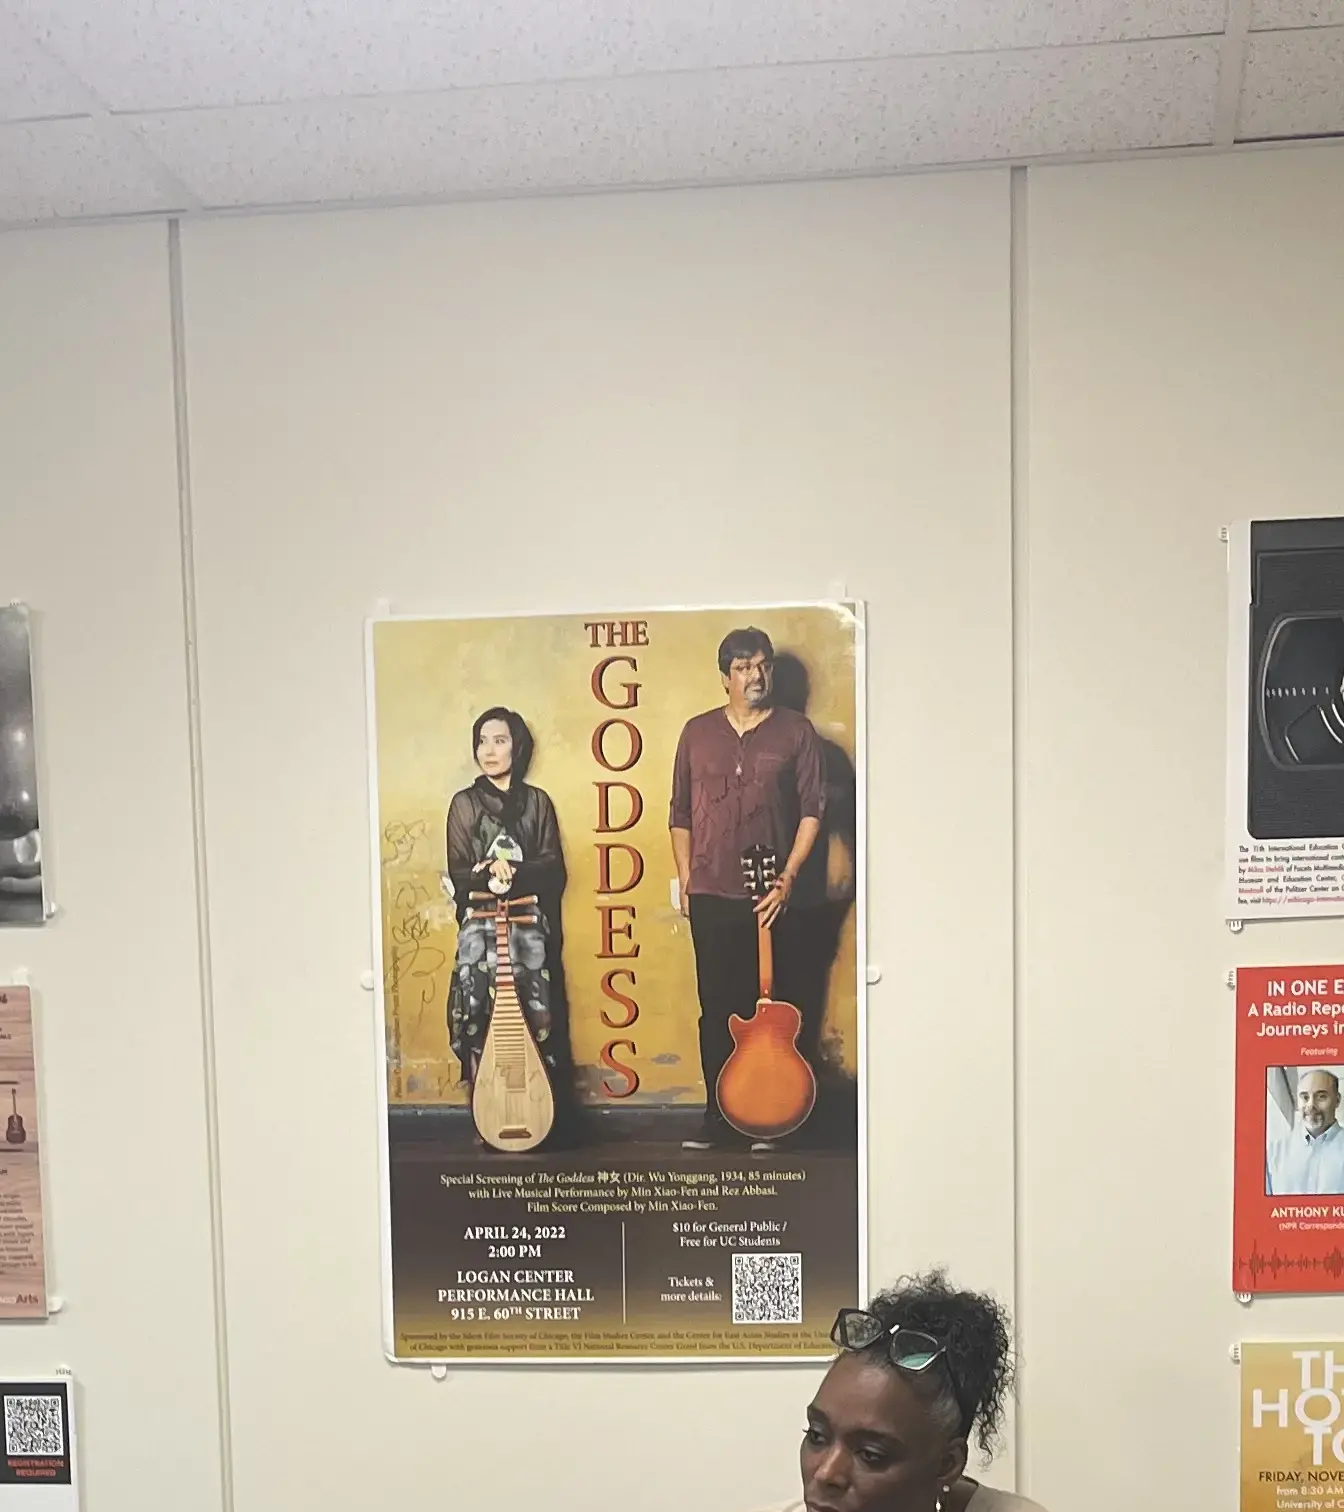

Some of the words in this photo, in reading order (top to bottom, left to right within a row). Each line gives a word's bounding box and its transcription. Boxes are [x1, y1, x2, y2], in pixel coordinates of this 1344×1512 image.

[585, 621, 649, 648] THE
[591, 656, 645, 1099] GODDESS
[1268, 980, 1285, 996] IN
[1291, 979, 1328, 996] ONE
[1248, 1003, 1259, 1017] A
[1263, 1001, 1306, 1017] Radio
[1256, 1022, 1328, 1039] Journeys
[440, 1174, 474, 1187] Special
[475, 1173, 523, 1187] Screening
[524, 1173, 535, 1184] of
[537, 1172, 554, 1184] The
[556, 1172, 595, 1185] Goddess
[648, 1170, 665, 1183] Wu
[667, 1170, 718, 1187] Yonggang,
[719, 1170, 745, 1184] 1934,
[748, 1170, 761, 1183] 85
[763, 1169, 807, 1185] minutes)
[468, 1187, 490, 1199] with
[492, 1187, 512, 1199] Live
[514, 1187, 552, 1199] Musical
[554, 1186, 615, 1199] Performance
[617, 1186, 628, 1201] by
[631, 1185, 652, 1198] Min
[654, 1185, 699, 1198] Xiao-Fen
[701, 1185, 719, 1198] and
[721, 1184, 739, 1198] Rez
[741, 1183, 778, 1197] Abbasi.
[527, 1201, 550, 1214] Film
[551, 1201, 578, 1213] Score
[579, 1201, 632, 1216] Composed
[634, 1201, 645, 1215] by
[648, 1199, 669, 1212] Min
[1271, 1206, 1329, 1218] ANTHONY
[464, 1227, 508, 1240] APRIL
[511, 1227, 531, 1240] 24,
[535, 1226, 566, 1239] 2022
[672, 1222, 691, 1233] $10
[693, 1221, 707, 1232] for
[709, 1221, 747, 1232] General
[750, 1220, 780, 1232] Public
[680, 1236, 701, 1247] Free
[703, 1236, 717, 1247] for
[719, 1236, 737, 1246] UC
[738, 1235, 781, 1247] Students
[488, 1245, 516, 1258] 2:00
[518, 1245, 542, 1258] PM
[457, 1270, 510, 1283] LOGAN
[514, 1270, 575, 1283] CENTER
[668, 1276, 703, 1287] Tickets
[704, 1276, 714, 1287] &
[438, 1289, 552, 1302] PERFORMANCE
[555, 1289, 595, 1301] HALL
[660, 1293, 686, 1301] more
[450, 1308, 475, 1320] 915
[478, 1307, 491, 1320] E.
[493, 1306, 522, 1320] 60TH
[525, 1307, 581, 1320] STREET
[1259, 1471, 1305, 1483] FRIDAY,
